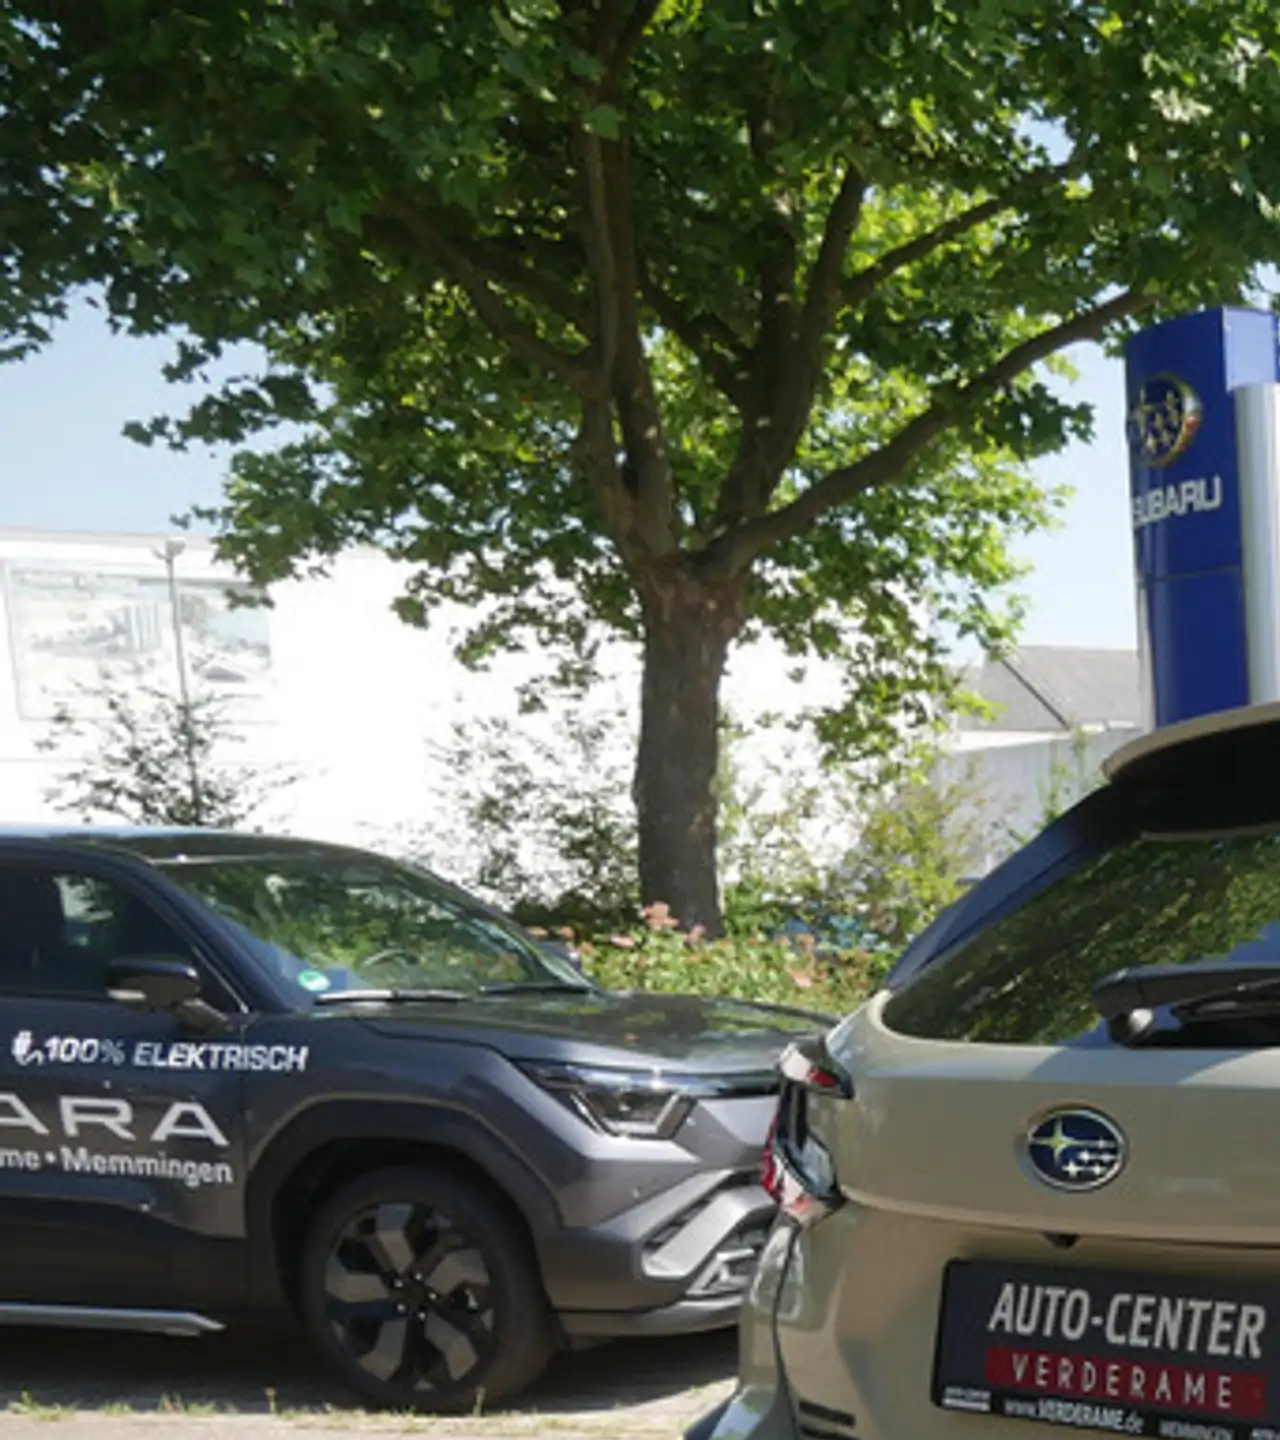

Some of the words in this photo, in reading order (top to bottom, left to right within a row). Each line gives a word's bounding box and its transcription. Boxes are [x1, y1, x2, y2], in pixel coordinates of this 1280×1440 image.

[44, 1036, 125, 1066] 100%
[131, 1042, 309, 1071] ELEKTRISCH
[60, 1145, 233, 1187] Memmingen
[988, 1282, 1267, 1359] AUTO-CENTER
[1010, 1352, 1233, 1408] VERDERAME
[1004, 1398, 1145, 1434] www.VERDERAME.de
